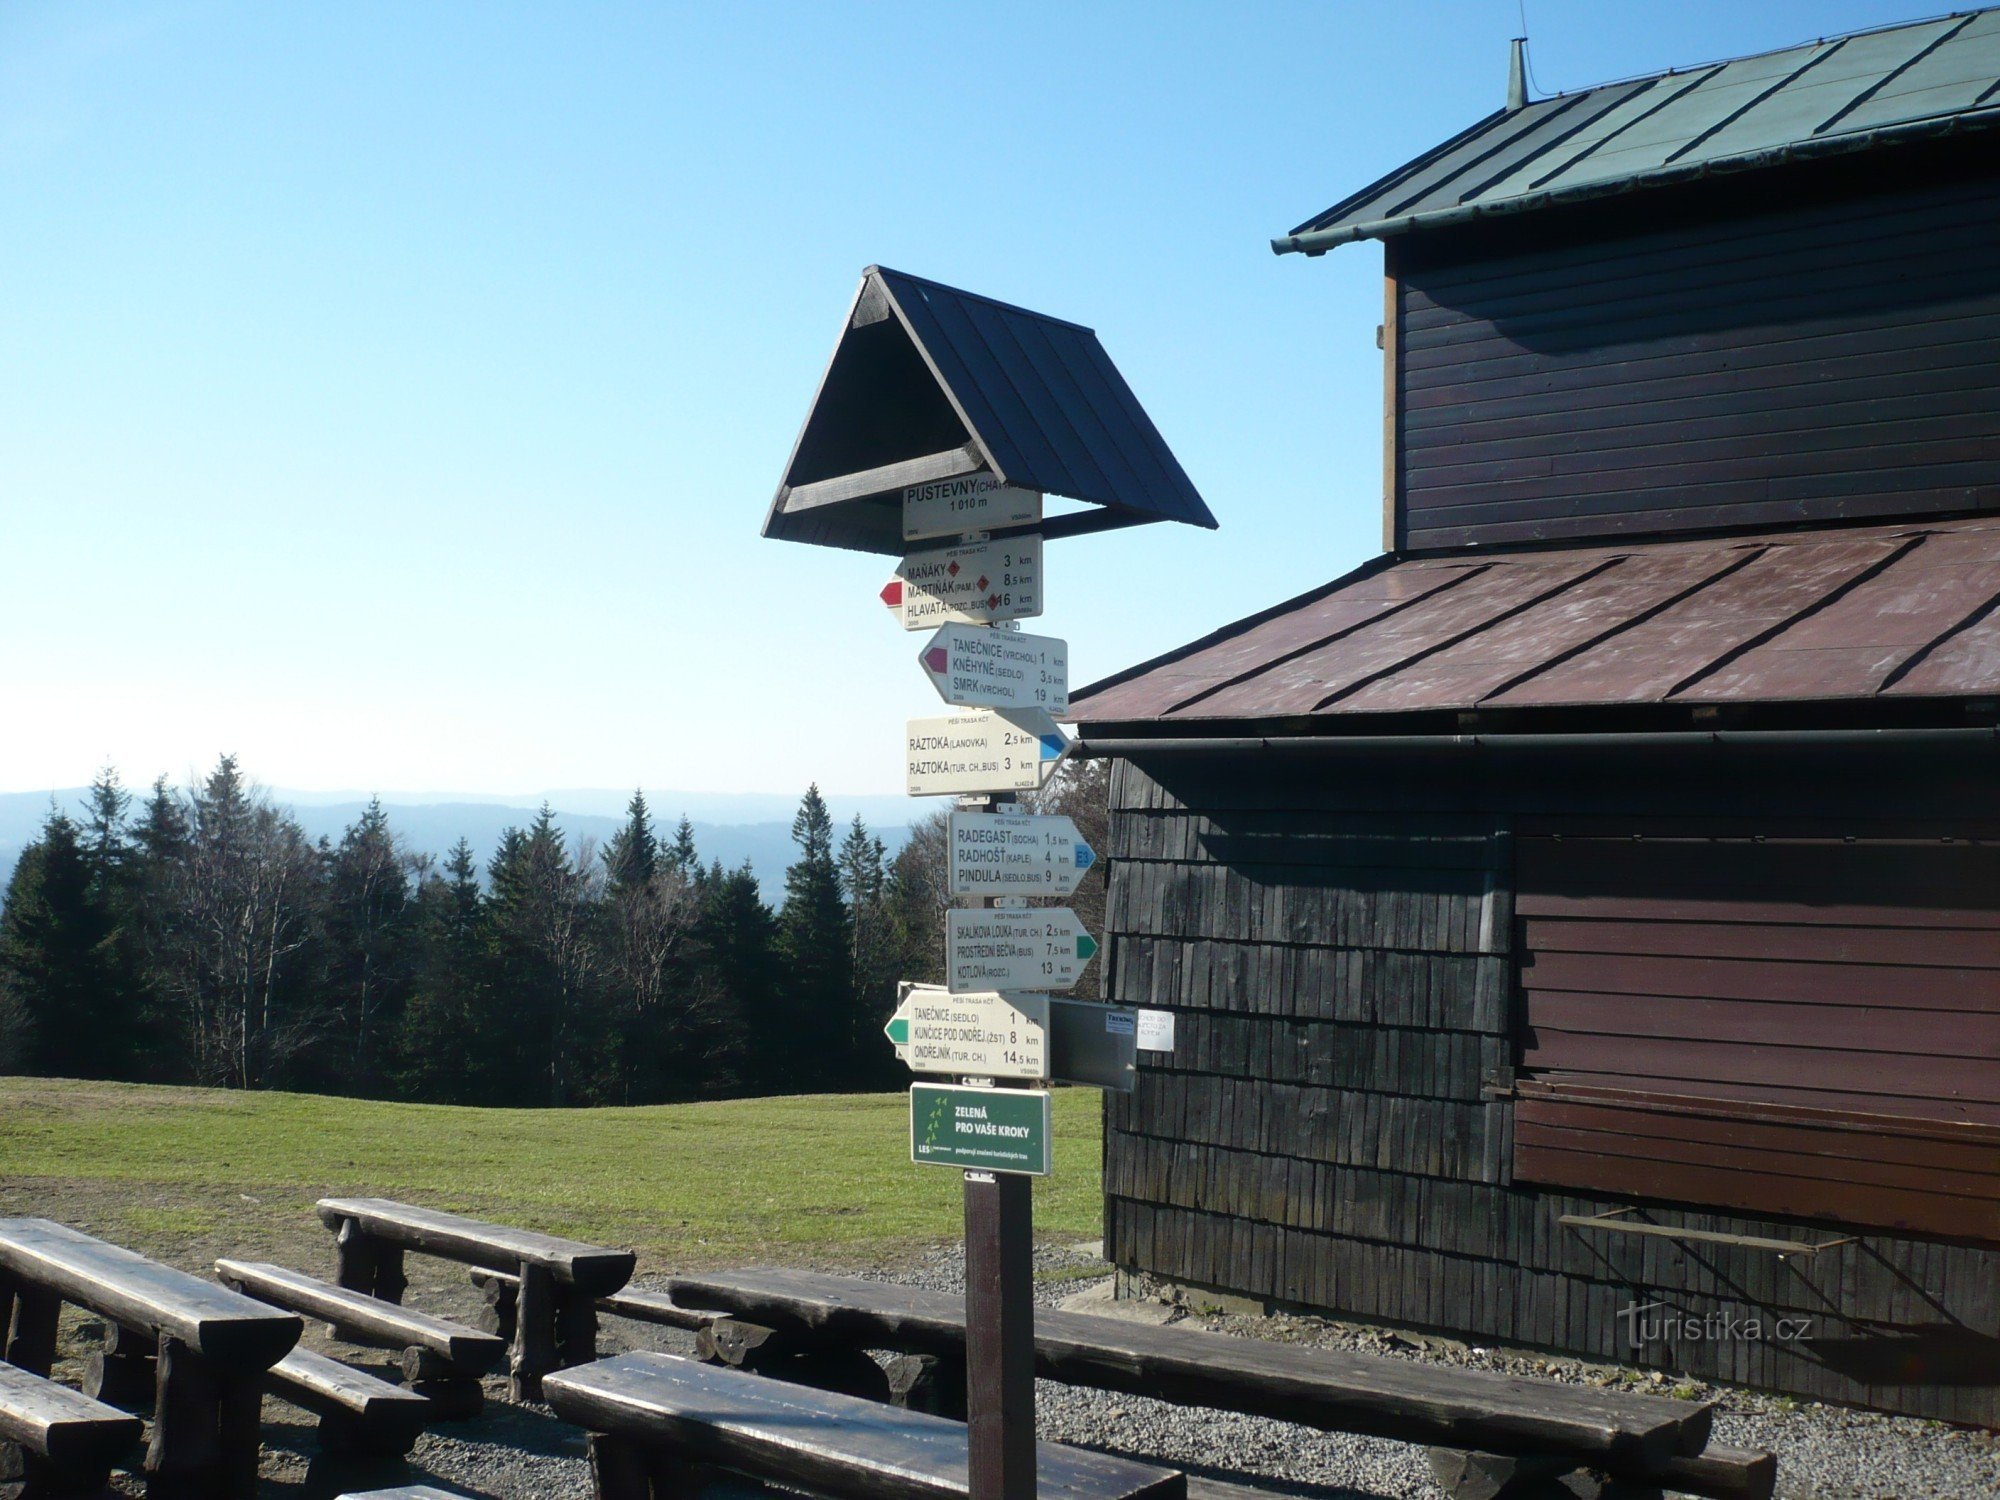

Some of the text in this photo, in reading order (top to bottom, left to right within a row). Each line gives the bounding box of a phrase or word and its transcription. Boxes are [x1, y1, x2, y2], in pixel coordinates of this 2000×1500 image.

[907, 479, 978, 503] PUSTEVNY
[958, 498, 976, 510] 010
[978, 498, 988, 507] m
[908, 554, 1032, 580] MAŇÁKY 3 km
[908, 580, 954, 598] MARTIŇÁK
[1004, 574, 1018, 588] 8,5
[1020, 575, 1032, 584] km
[908, 598, 948, 618] HLAVATÁ
[998, 593, 1011, 606] 16
[1020, 595, 1032, 604] km
[953, 638, 1064, 666] TANEČNICE (VRCHOL) 1 km
[953, 656, 1064, 685] KNĚHYNĚ (SEDLO) 3,5 km
[954, 677, 1064, 704] SMRK (VRCHOL) 19 km
[910, 732, 1032, 750] RÁZTOKA (LANOVKA) 2,5 km
[910, 760, 949, 774] RÁZTOKA
[950, 764, 967, 774] (TUR.
[1004, 758, 1011, 770] 3
[1020, 761, 1032, 770] km
[958, 829, 1068, 846] RADEGAST (SOCHA) 1,5 km
[958, 847, 1088, 864] RADHOŠŤ (KAPLE) 4 km E3
[958, 869, 1001, 882] PINDULA
[1046, 870, 1052, 882] 9
[1059, 874, 1070, 882] km
[958, 924, 990, 938] SKALÍKOVA
[992, 924, 1012, 936] LOUKA
[1013, 928, 1028, 938] (TUR.
[1046, 924, 1058, 937] 2,5
[958, 943, 996, 958] PROSTŘEDNÍ
[996, 942, 1016, 957] BEČVA
[1016, 948, 1034, 958] (BUS)
[1046, 943, 1058, 956] 7,5
[958, 964, 986, 978] KOTLOVÁ
[986, 968, 1010, 978] (ROZC.)
[1042, 962, 1052, 974] 13
[914, 1006, 950, 1021] TANEČNICE
[950, 1014, 979, 1024] (SEDLO)
[1010, 1012, 1015, 1024] 1
[914, 1025, 942, 1040] KUNČICE
[944, 1028, 958, 1041] POD
[986, 1032, 1006, 1044] (ŽST)
[1010, 1032, 1016, 1044] 8
[1026, 1036, 1038, 1045] km
[914, 1042, 1038, 1065] ONDŘEJNÍK (TUR. CH.) 14,5 km
[955, 1106, 988, 1119] ZELENÁ
[956, 1122, 1030, 1138] PRO VAŠE KROKY
